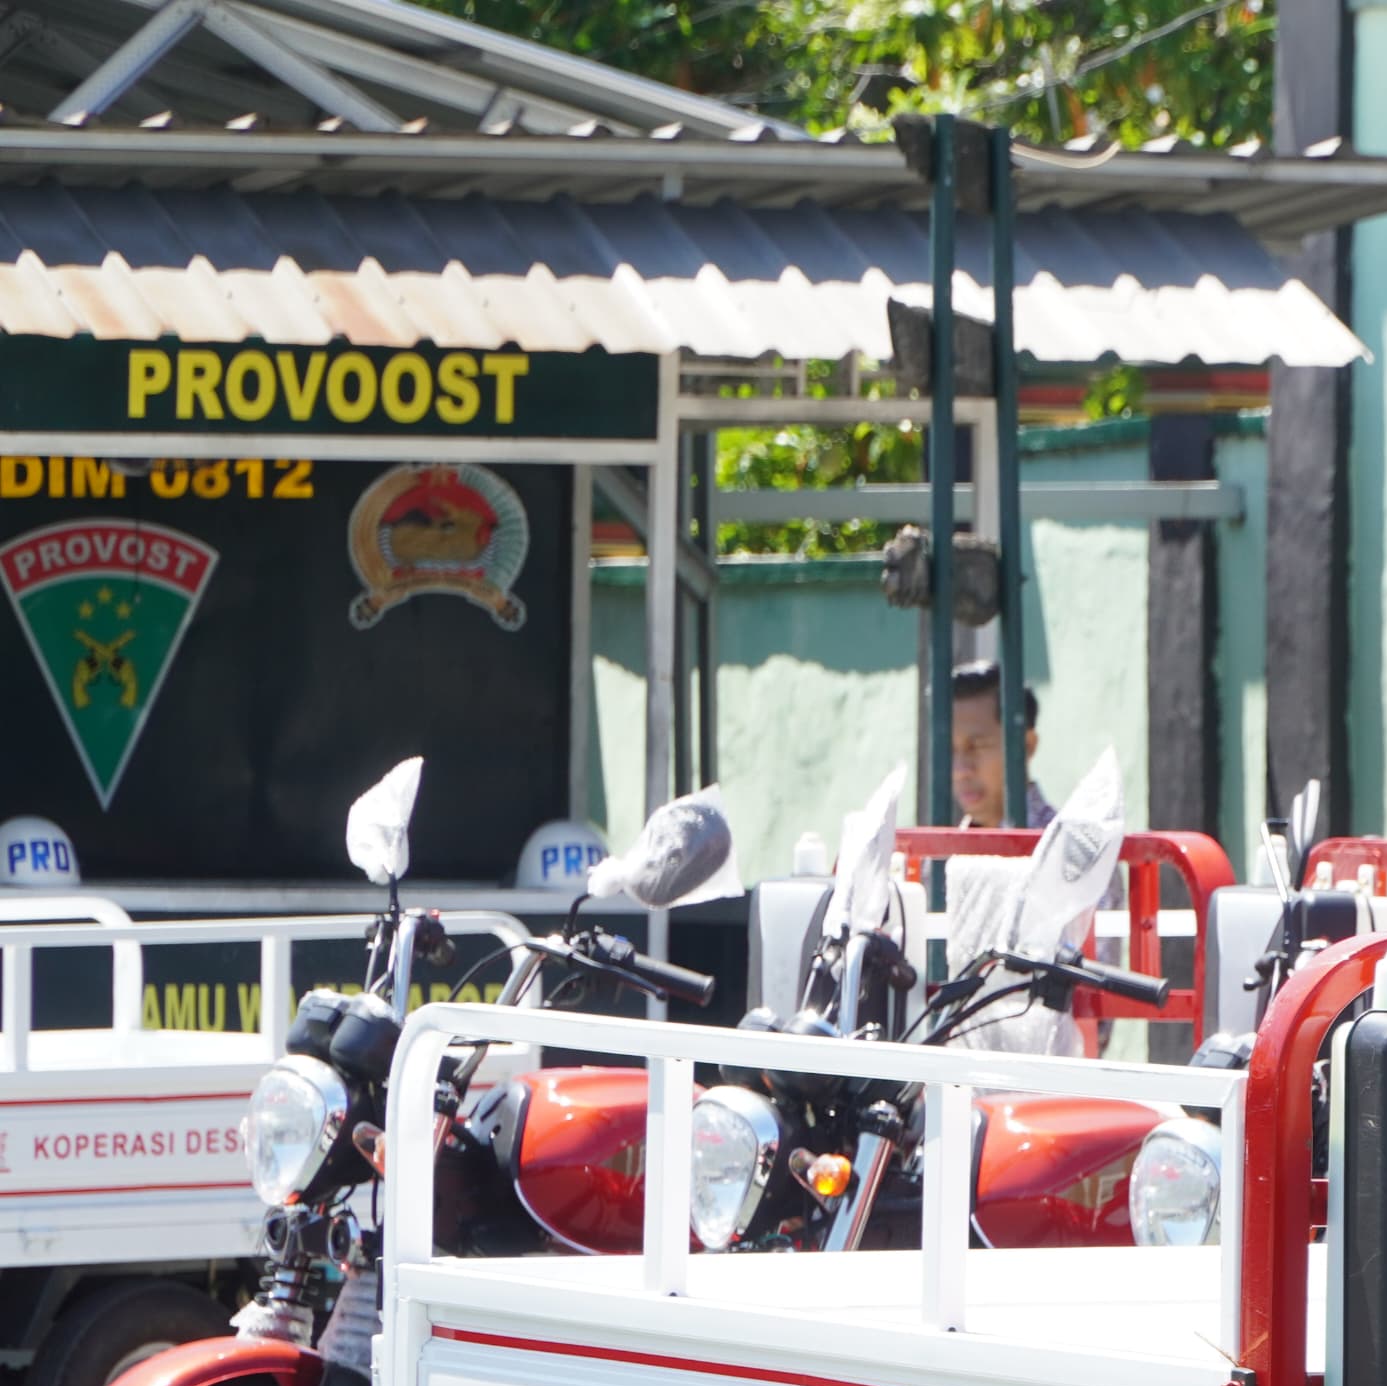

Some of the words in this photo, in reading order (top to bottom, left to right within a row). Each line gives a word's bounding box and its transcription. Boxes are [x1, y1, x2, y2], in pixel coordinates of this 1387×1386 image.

[127, 349, 529, 424] PROVOOST
[151, 458, 315, 498] 0812
[13, 533, 198, 581] PROVOST
[142, 983, 226, 1031] AMU
[34, 1132, 175, 1159] KOPERASI
[186, 1128, 248, 1154] DES
